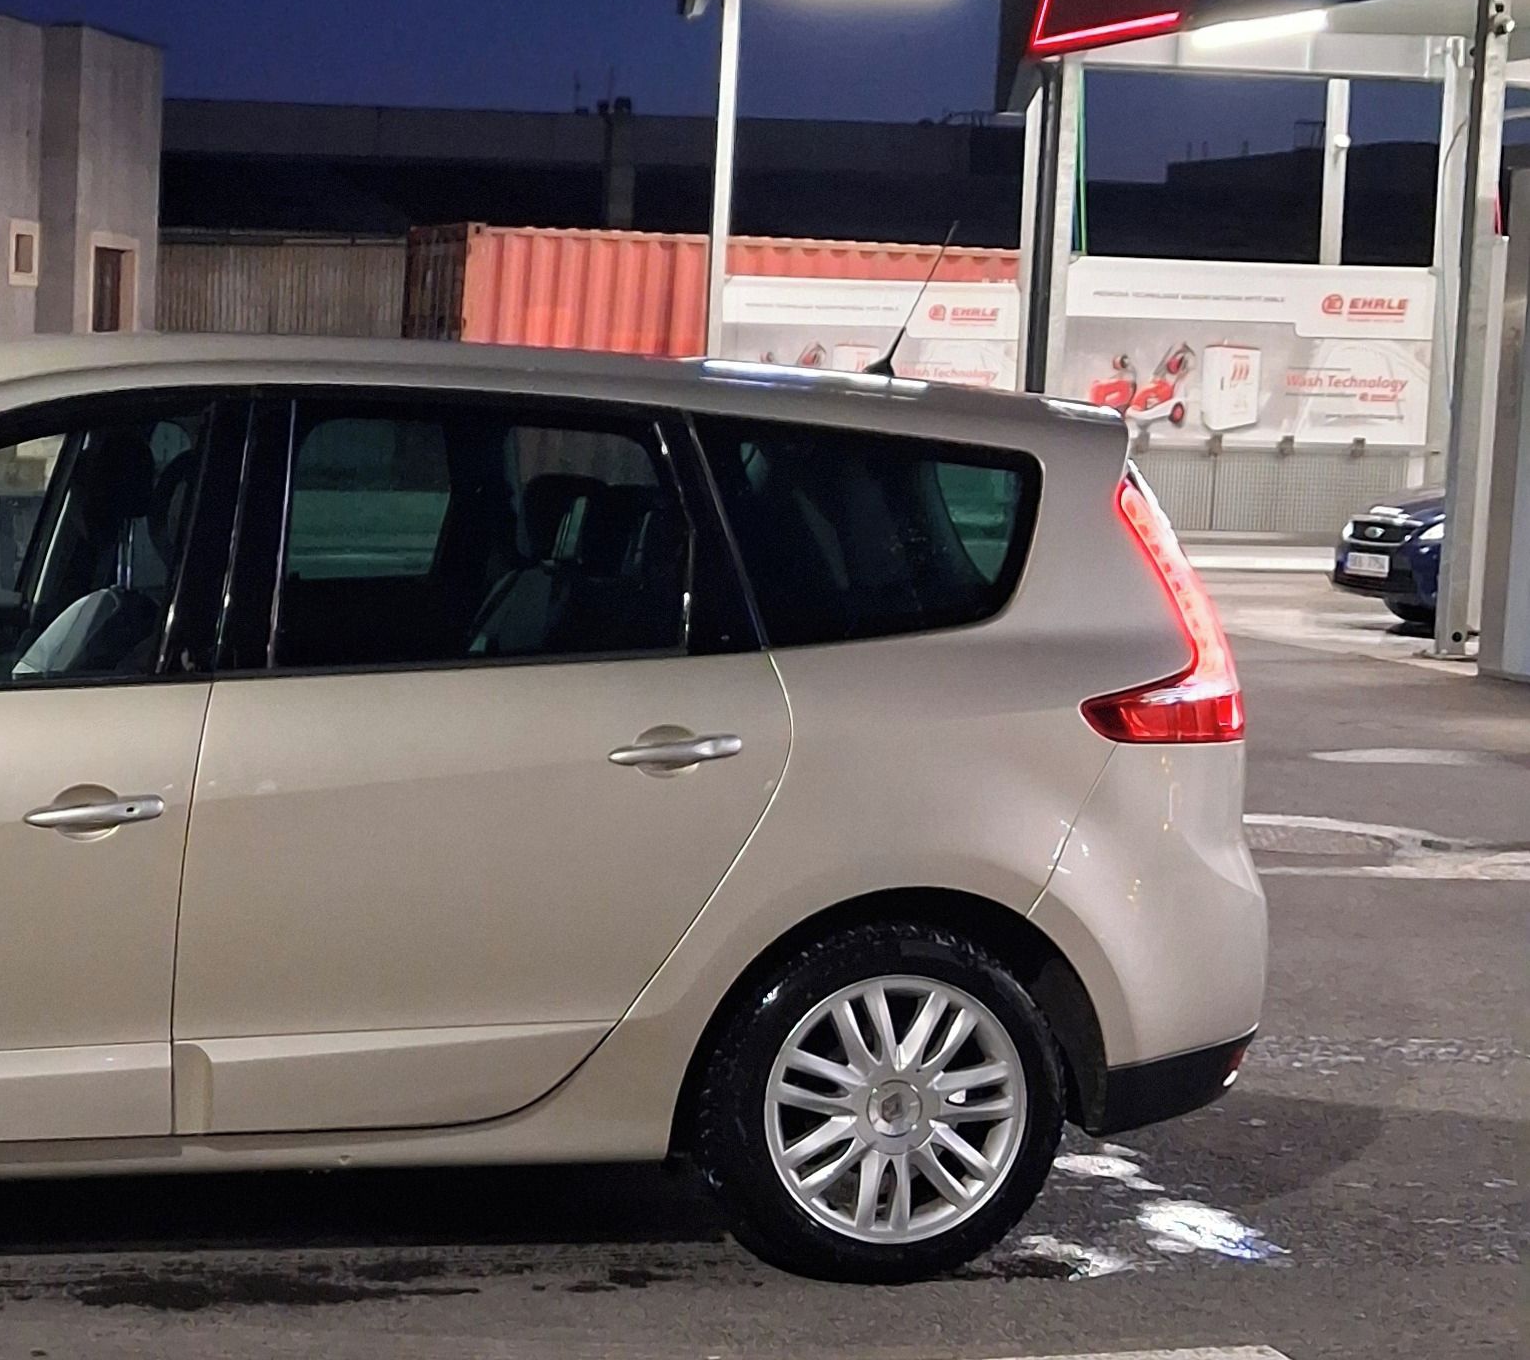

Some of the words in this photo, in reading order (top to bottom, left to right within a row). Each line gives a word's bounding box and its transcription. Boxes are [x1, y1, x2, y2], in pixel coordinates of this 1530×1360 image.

[1348, 297, 1409, 310] EHRLE
[950, 306, 1001, 317] EHRLE
[1286, 373, 1323, 388] Wash
[1327, 374, 1408, 393] Technology
